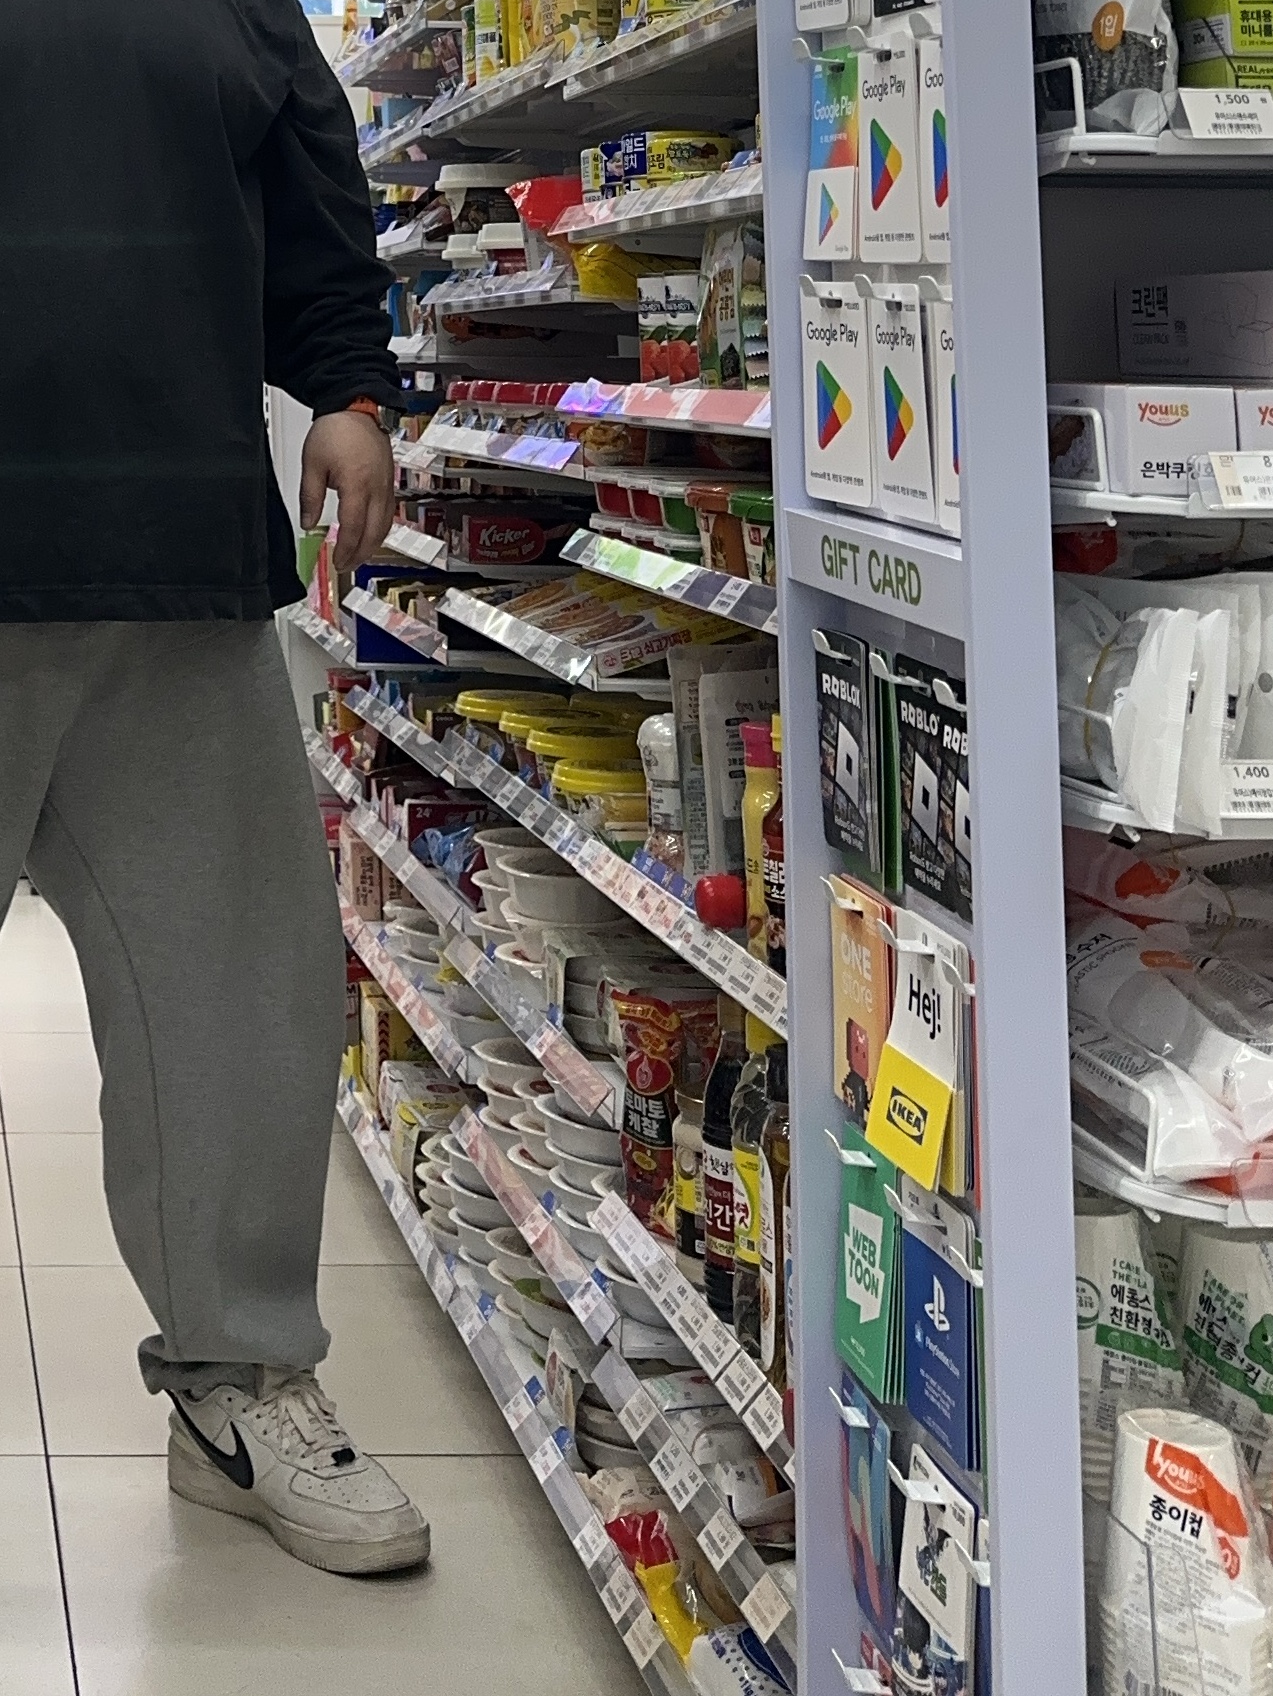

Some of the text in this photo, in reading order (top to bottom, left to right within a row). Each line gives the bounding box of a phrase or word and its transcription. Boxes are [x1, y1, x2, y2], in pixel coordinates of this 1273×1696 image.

[862, 74, 906, 102] Google Play
[1215, 94, 1250, 105] 1,500
[813, 100, 840, 124] Google
[807, 321, 859, 349] Google Play
[875, 324, 900, 351] Google
[900, 326, 916, 353] Play
[1138, 401, 1190, 423] youus
[479, 524, 530, 547] Kicker
[821, 534, 922, 607] GIFT CARD
[900, 700, 940, 737] ROBLO
[1233, 765, 1271, 779] 1,400
[840, 930, 873, 982] ONE
[908, 972, 942, 1041] Hej!
[890, 1099, 925, 1135] IKEA
[851, 1226, 878, 1269] WEB
[848, 1247, 880, 1300] TOON
[1149, 1494, 1204, 1540] 종이컵
